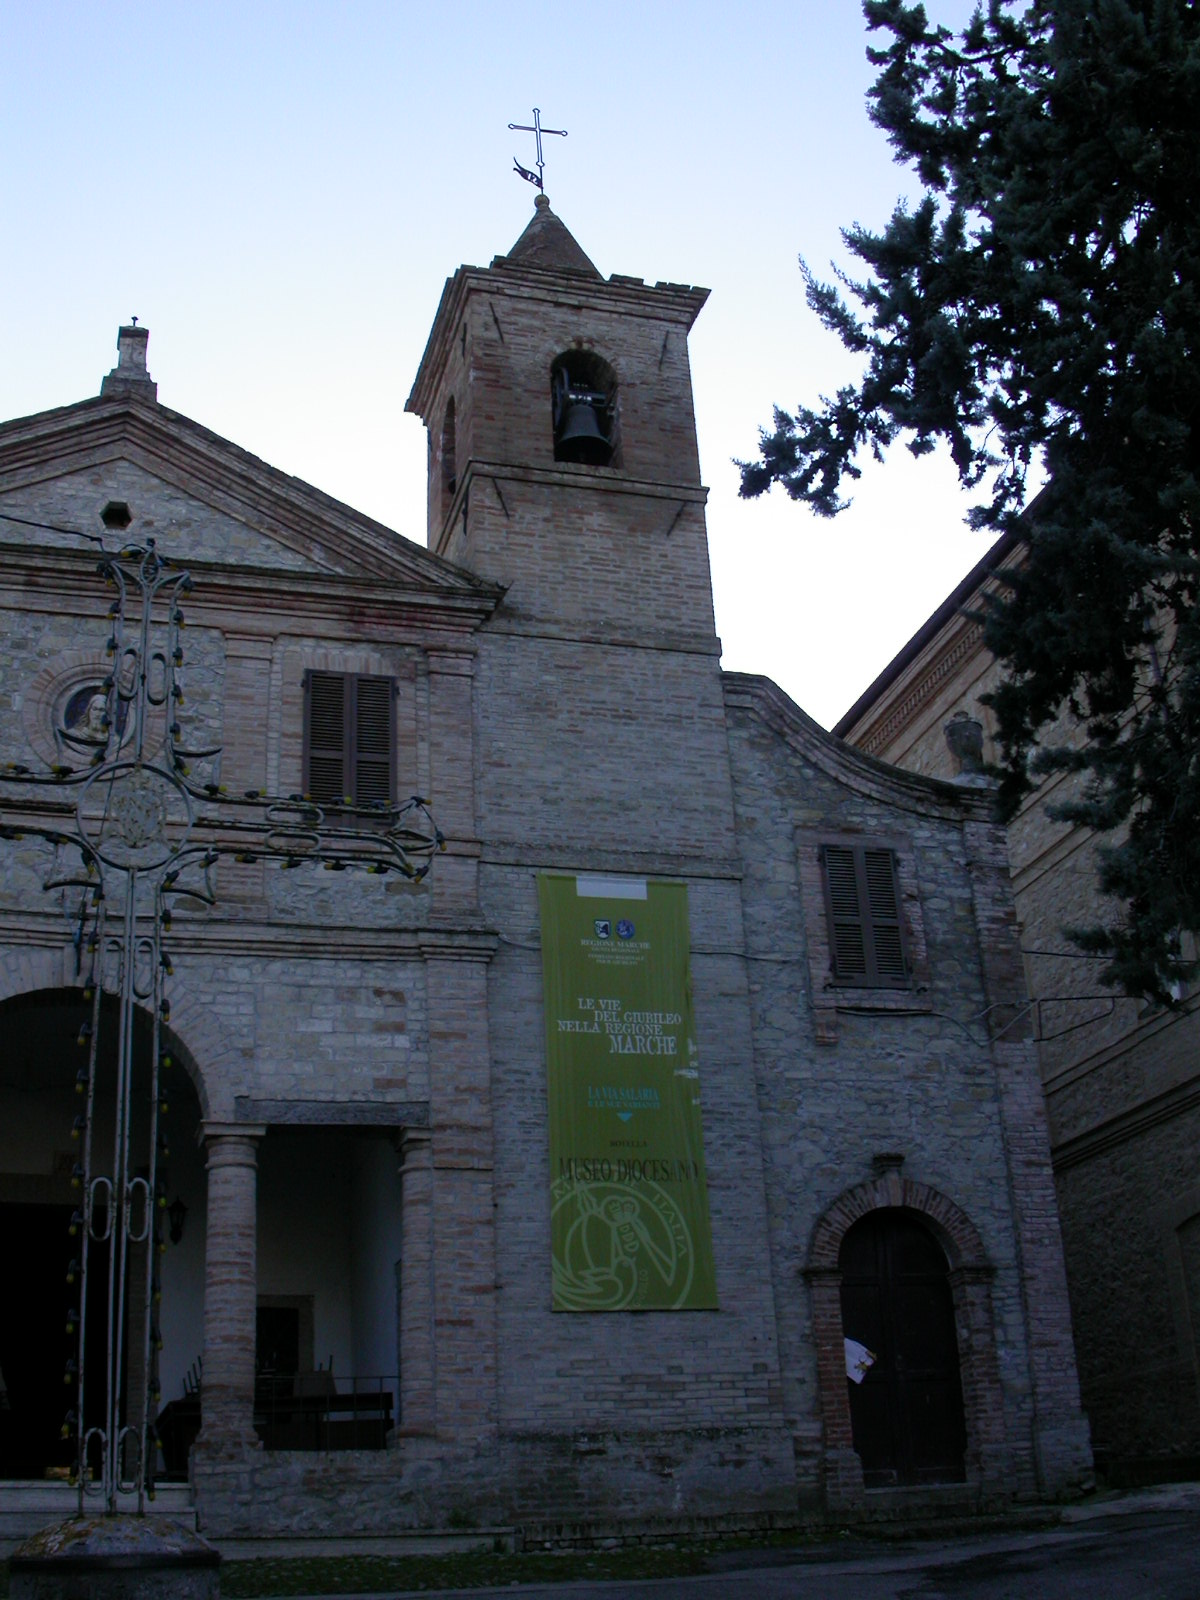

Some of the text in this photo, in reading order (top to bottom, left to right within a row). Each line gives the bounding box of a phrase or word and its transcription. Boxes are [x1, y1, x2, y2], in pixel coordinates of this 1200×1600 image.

[577, 998, 621, 1011] LE VIE
[594, 1010, 682, 1025] DEL GIUBILEO
[557, 1020, 663, 1036] NELLA REGIONE
[609, 1034, 677, 1055] MARCHE
[560, 1158, 612, 1181] MUSEO
